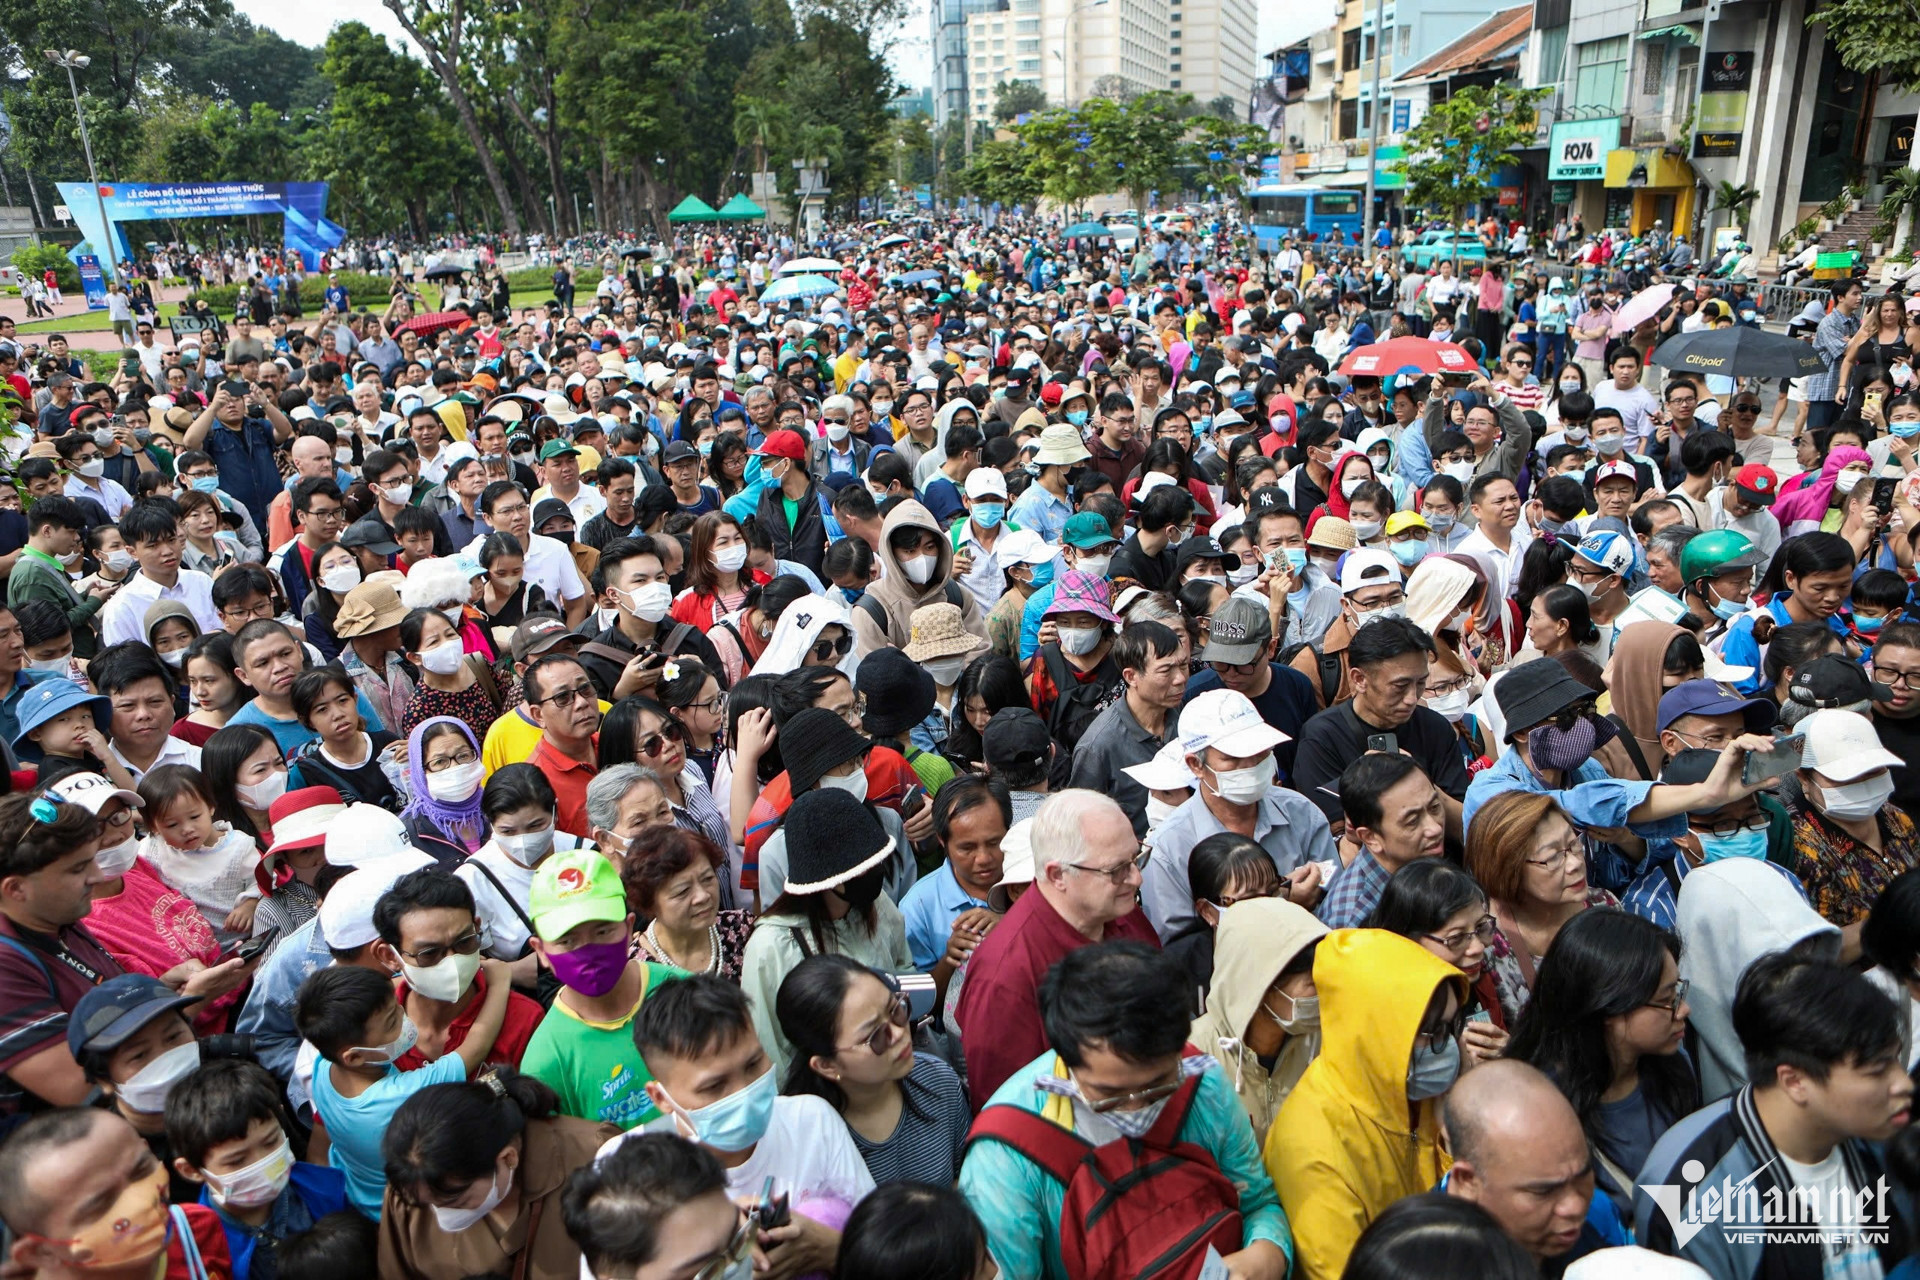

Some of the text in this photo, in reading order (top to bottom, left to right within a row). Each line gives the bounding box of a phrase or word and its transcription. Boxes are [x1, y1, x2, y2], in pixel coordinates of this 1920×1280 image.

[1564, 142, 1593, 160] FO76
[138, 188, 161, 198] CÔNG
[162, 187, 174, 197] BỐ
[193, 186, 216, 196] HÀNH
[217, 185, 242, 194] CHÍNH
[1685, 354, 1725, 367] Citigold
[1214, 620, 1246, 635] BOSS
[57, 952, 95, 978] SONY
